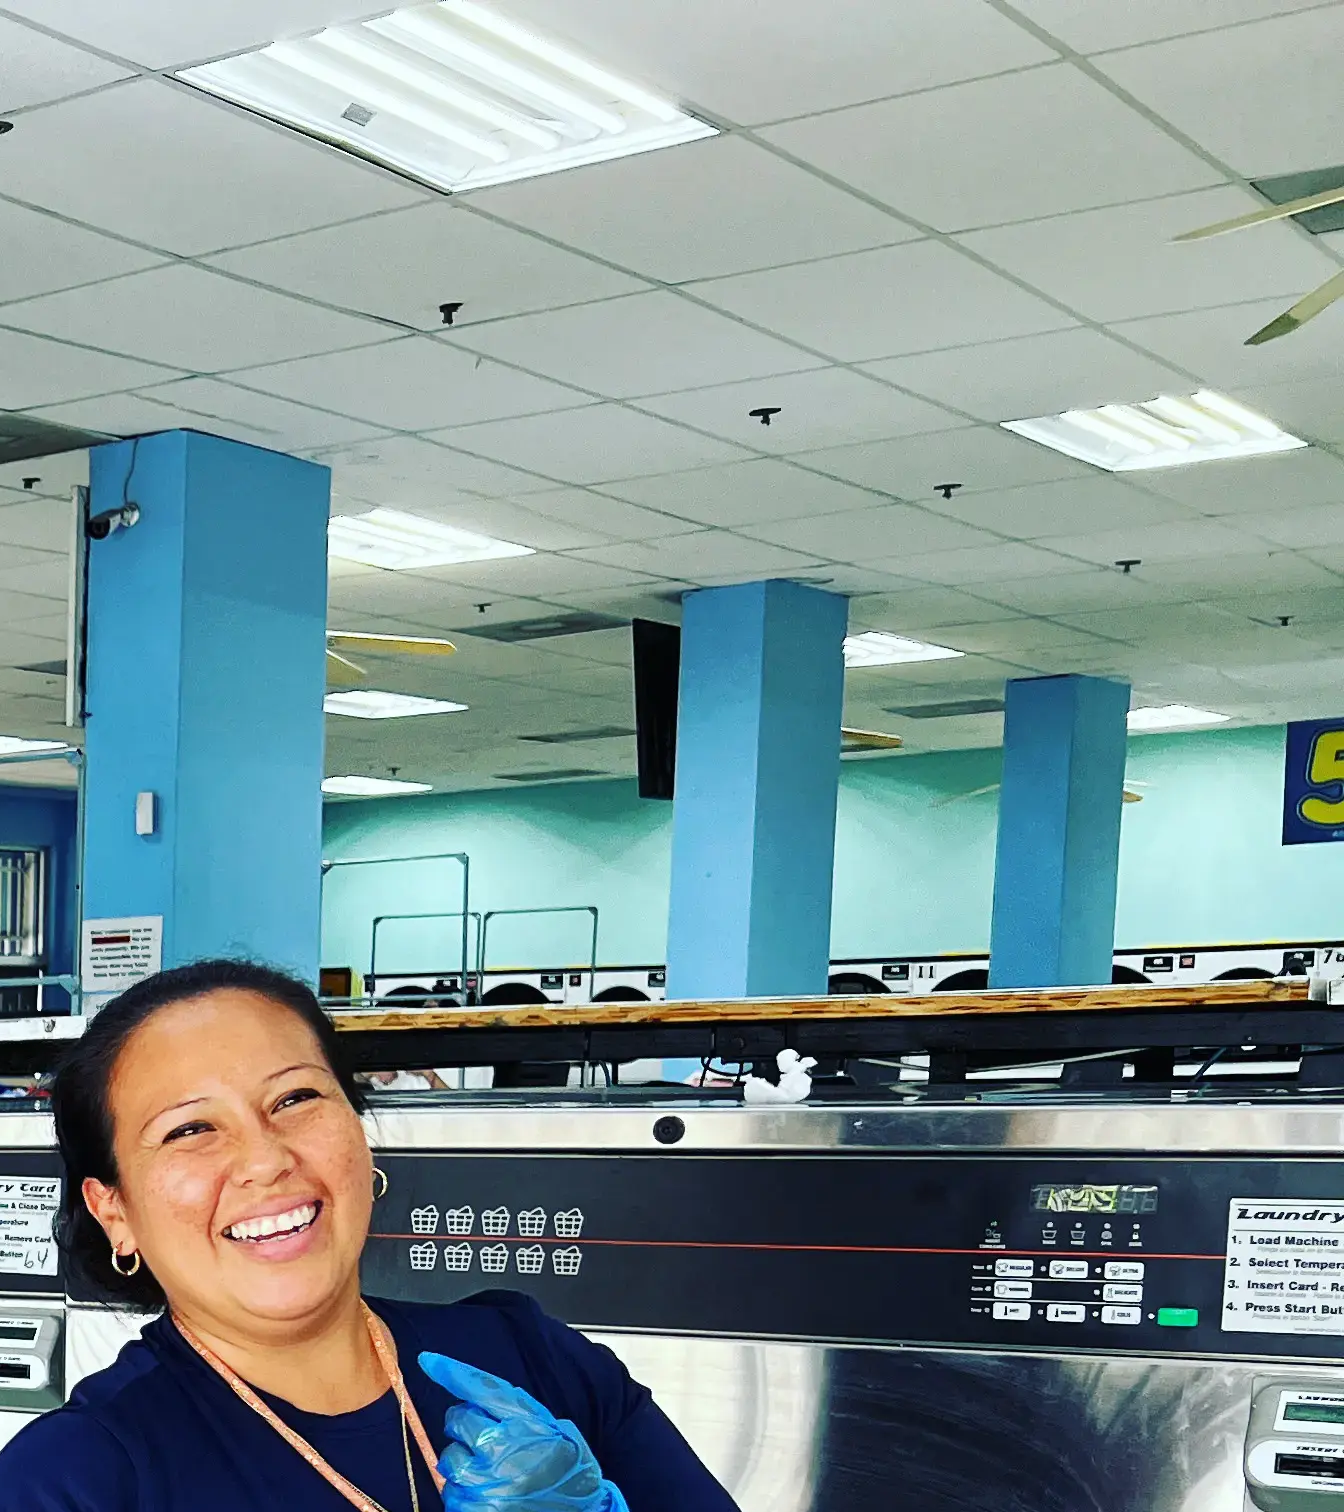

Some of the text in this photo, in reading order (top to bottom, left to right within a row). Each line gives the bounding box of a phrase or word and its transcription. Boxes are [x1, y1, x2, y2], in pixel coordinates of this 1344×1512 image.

[20, 1183, 57, 1193] Card
[1236, 1208, 1344, 1223] Laundry
[1249, 1235, 1281, 1245] Load
[1284, 1236, 1339, 1247] Machine
[1229, 1257, 1241, 1267] 2.
[1248, 1257, 1289, 1268] Select
[1227, 1279, 1240, 1289] 3.
[1247, 1279, 1284, 1291] Insert
[1288, 1280, 1319, 1291] Card
[1225, 1301, 1238, 1311] 4.
[1245, 1302, 1281, 1313] Press
[1284, 1303, 1317, 1314] Start
